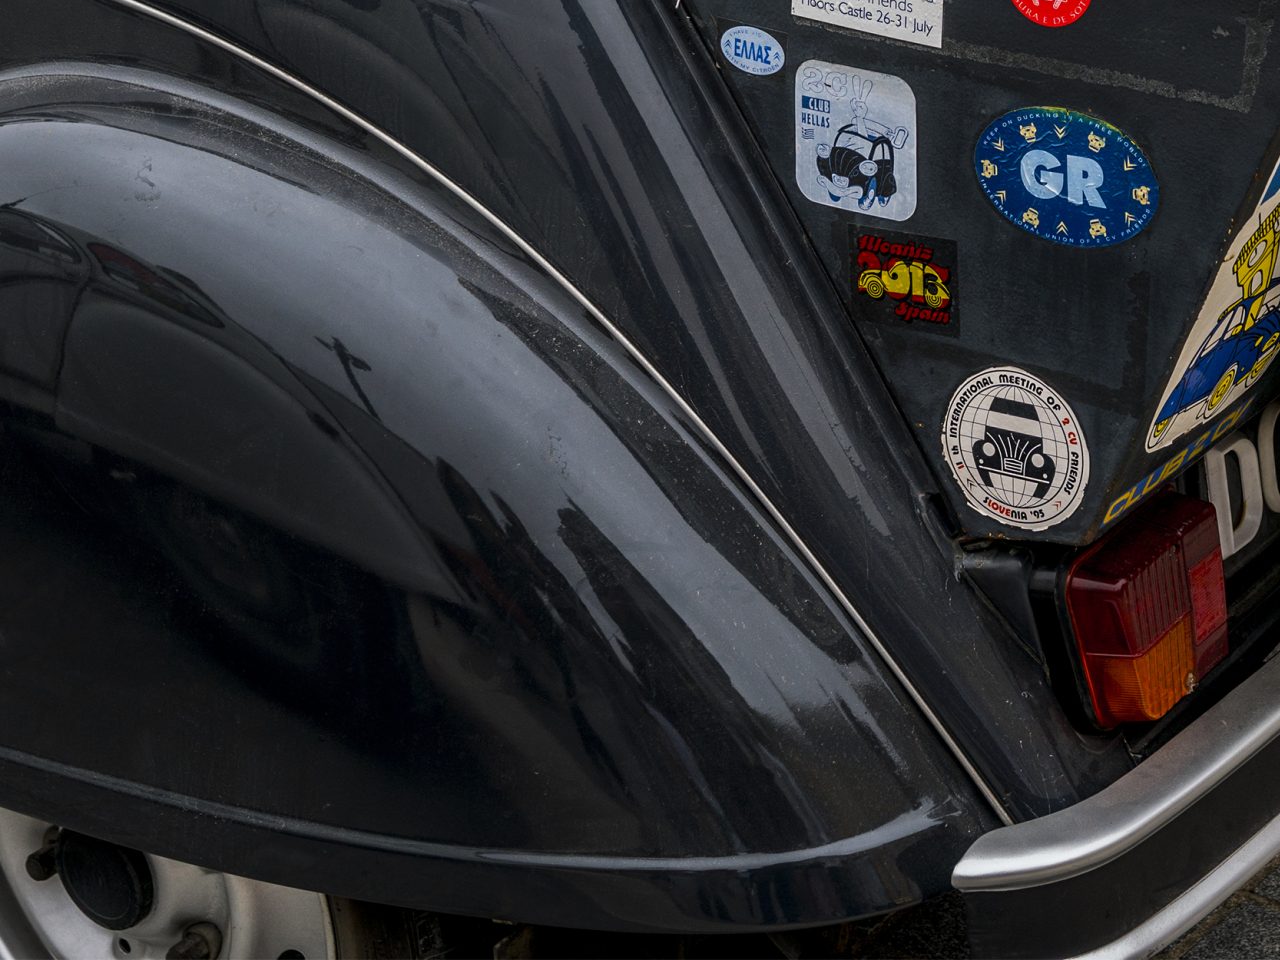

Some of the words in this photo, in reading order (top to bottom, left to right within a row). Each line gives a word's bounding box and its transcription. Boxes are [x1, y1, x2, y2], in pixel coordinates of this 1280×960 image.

[838, 1, 873, 21] Castle
[876, 9, 908, 29] 26-31
[912, 18, 934, 37] July
[808, 98, 830, 113] CLUB
[801, 112, 830, 128] HELLAS
[1002, 119, 1013, 128] ON
[1016, 112, 1060, 122] DUCKING
[1020, 149, 1107, 209] GR
[980, 178, 1040, 235] INTERNATIONAL
[1045, 232, 1074, 244] UNION
[1105, 234, 1117, 242] CV
[1120, 208, 1151, 237] FRIENDS
[895, 301, 951, 325] Spain
[998, 374, 1044, 396] MEETING
[949, 376, 994, 439] INTERNATIONAL
[1046, 396, 1062, 412] OF
[1061, 417, 1070, 426] 2
[1067, 431, 1078, 446] CV
[1063, 451, 1079, 496] FRIENDS
[983, 496, 1028, 521] SLOVENIA
